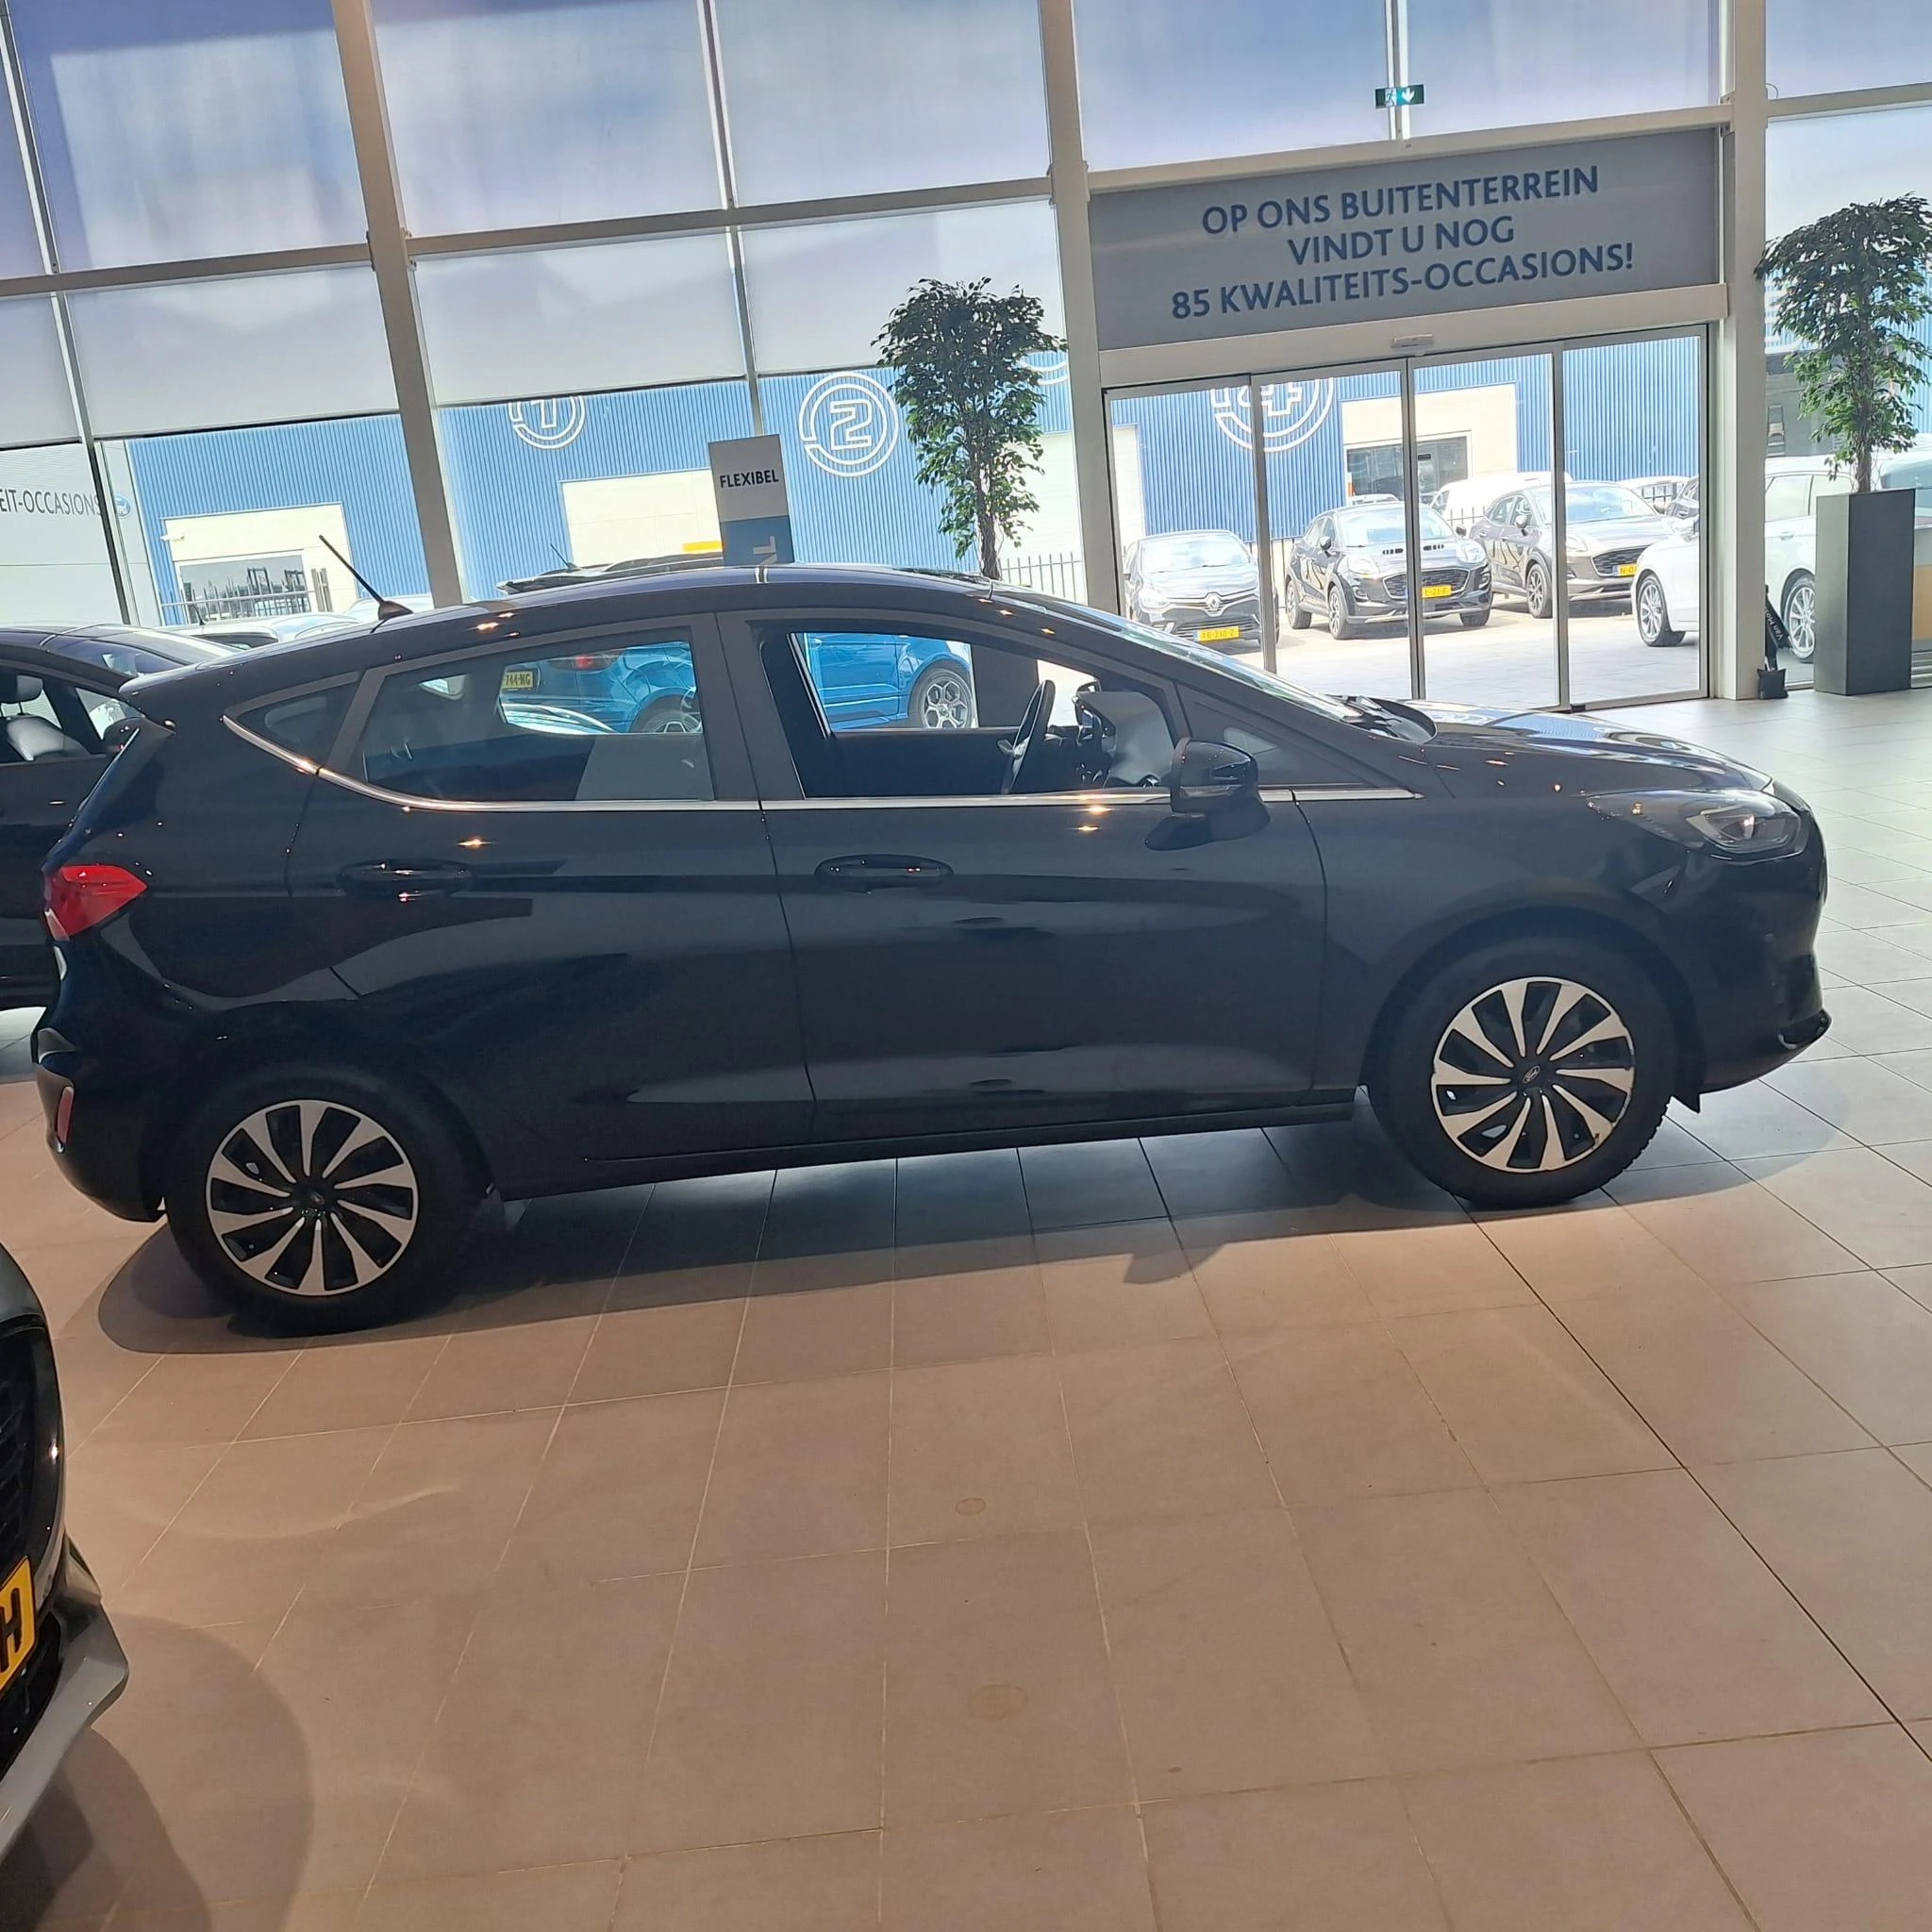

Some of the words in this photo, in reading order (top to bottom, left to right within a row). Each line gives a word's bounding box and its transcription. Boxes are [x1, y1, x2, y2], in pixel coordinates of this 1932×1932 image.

[1202, 204, 1248, 234] OP
[1257, 193, 1331, 229] ONS
[1341, 165, 1598, 221] BUITENTERREIN
[1288, 227, 1393, 265] VINDT
[1402, 225, 1424, 253] U
[1435, 215, 1514, 250] NOG
[1172, 288, 1210, 319] 85
[1220, 242, 1633, 314] KWALITEITS-OCCASIONS!
[720, 469, 779, 489] FLEXIBEL
